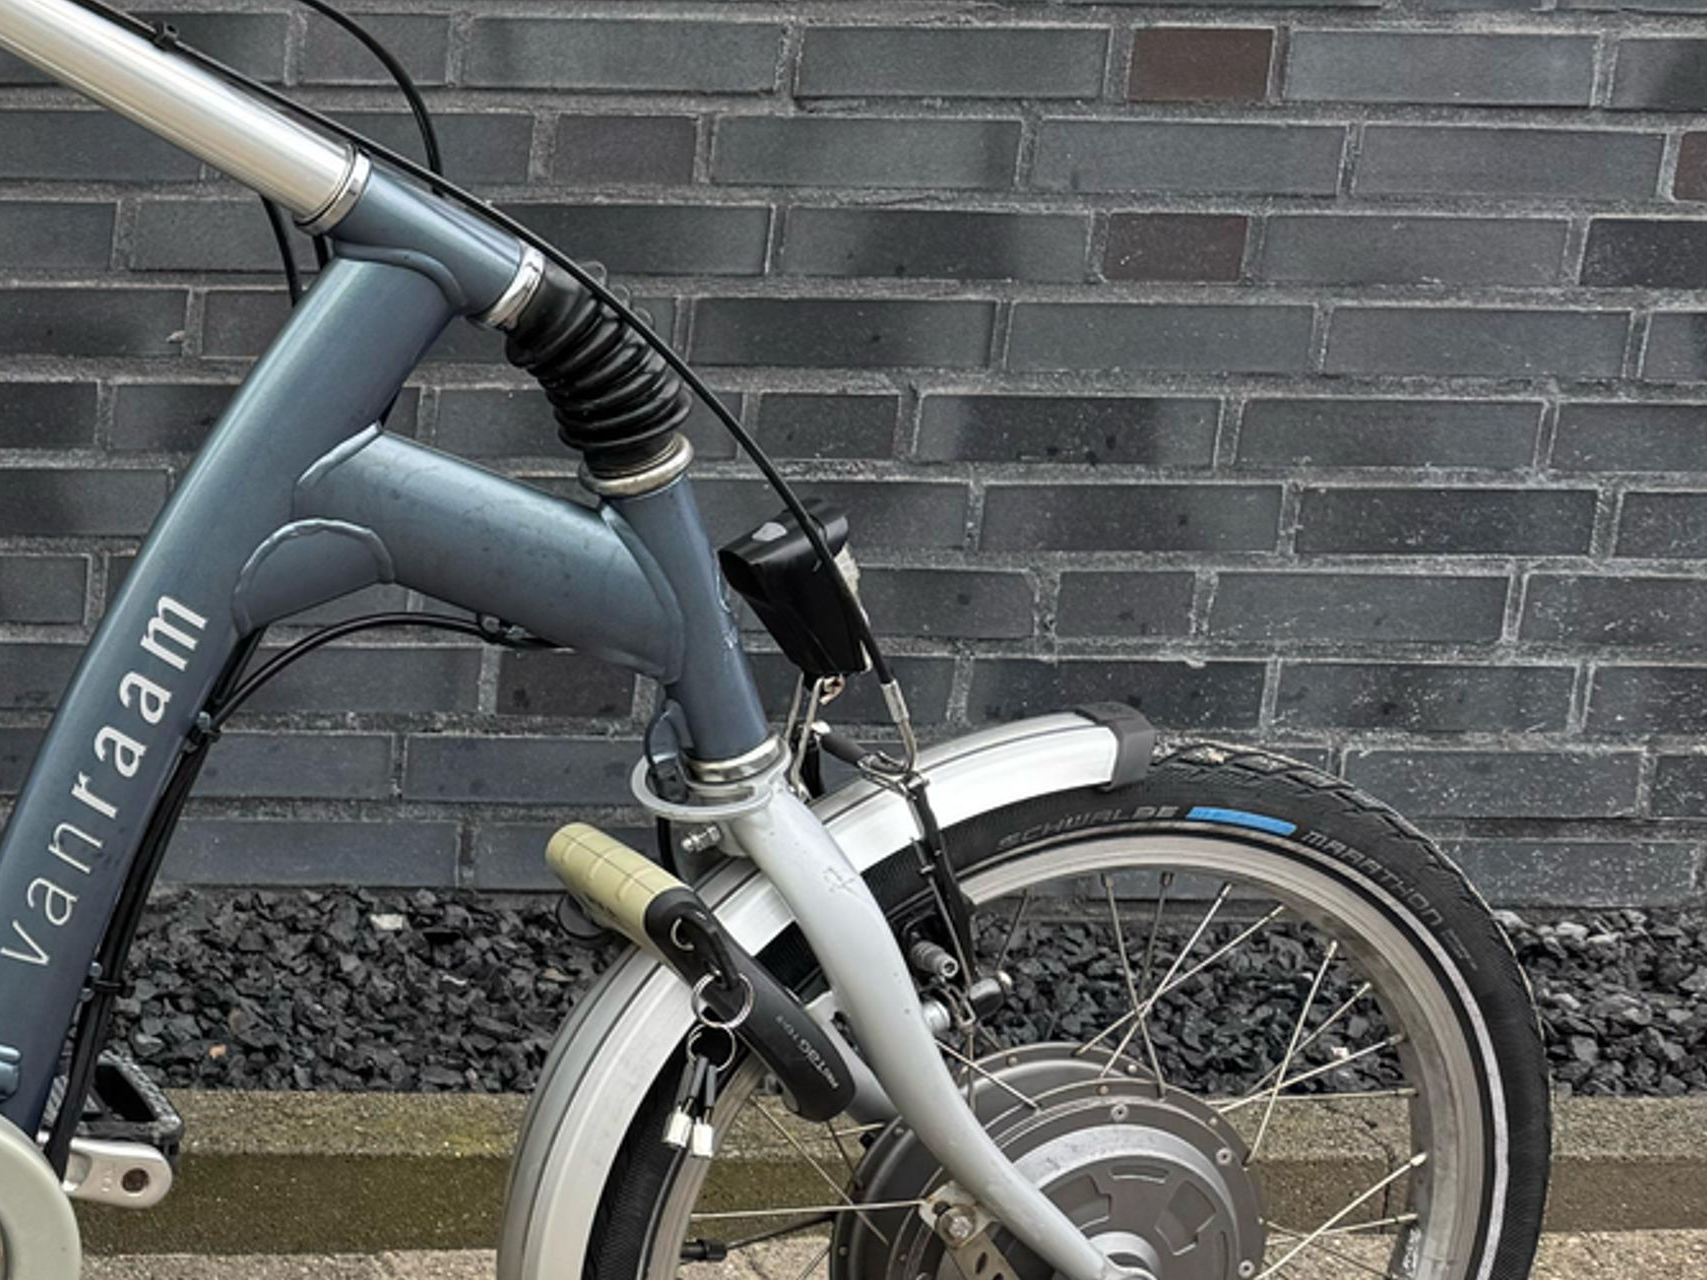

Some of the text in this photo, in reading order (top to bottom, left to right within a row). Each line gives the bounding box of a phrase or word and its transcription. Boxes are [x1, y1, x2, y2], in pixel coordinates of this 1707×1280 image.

[0, 594, 208, 966] vanraam
[997, 805, 1179, 851] SCHWALBE
[1302, 829, 1444, 926] MARATHON
